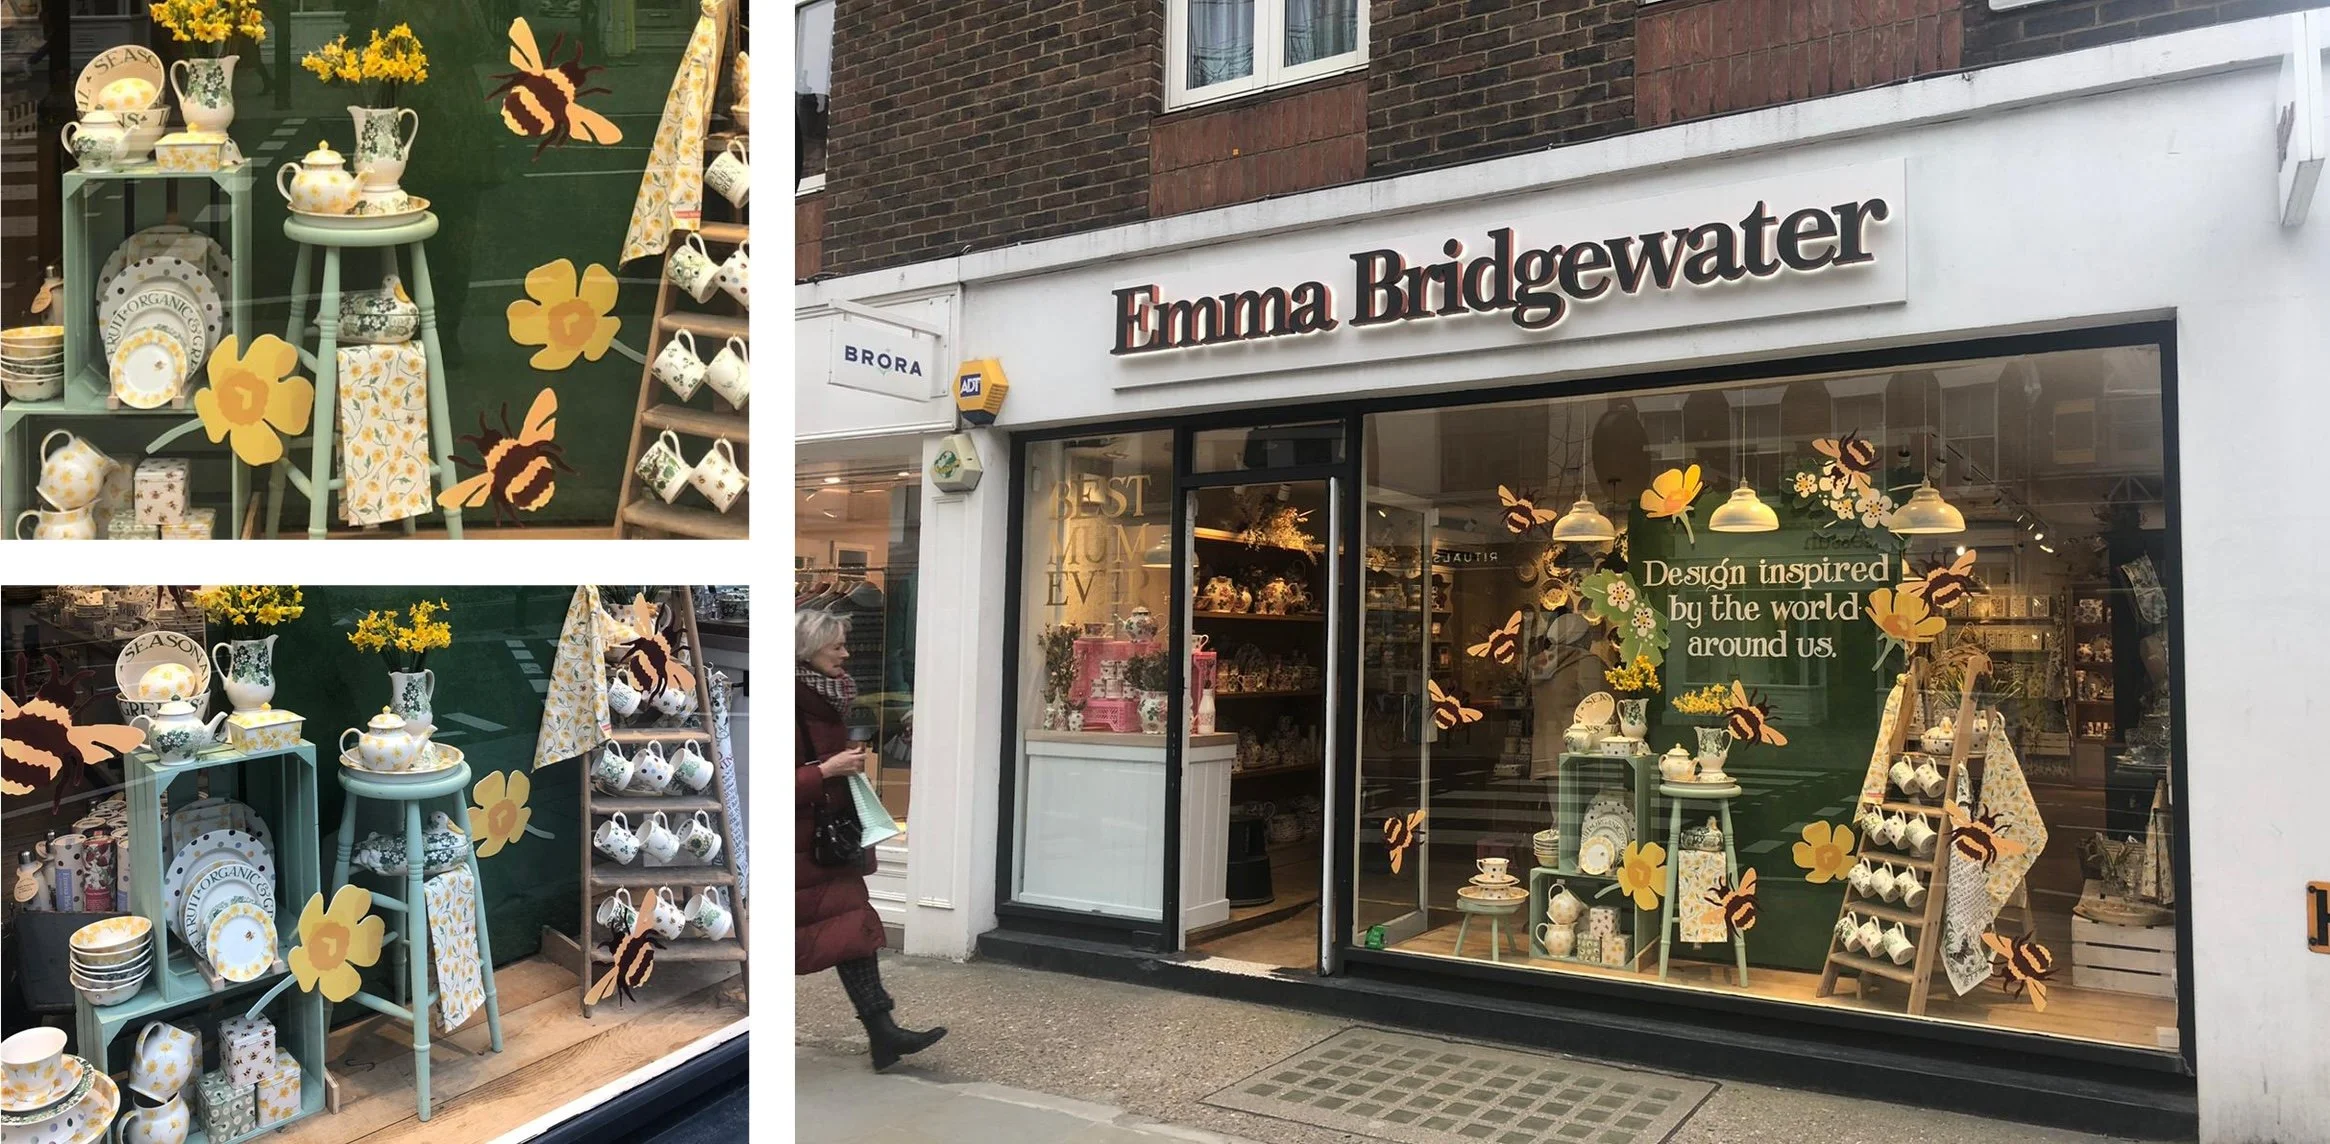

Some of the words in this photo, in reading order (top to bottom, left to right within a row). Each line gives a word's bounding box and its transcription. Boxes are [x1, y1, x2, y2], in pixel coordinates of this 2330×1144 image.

[1110, 282, 1339, 356] Emma
[1348, 199, 1888, 331] Bridgewater
[127, 293, 194, 318] ORGANIC
[845, 345, 922, 377] BRORA
[960, 377, 981, 394] ADT
[1049, 475, 1152, 520] BEST
[1047, 523, 1150, 565] MUM
[1643, 557, 1747, 592] Design
[1759, 553, 1890, 590] inspired
[1668, 594, 1703, 628] by
[1710, 594, 1761, 621] the
[1771, 592, 1859, 621] world
[1687, 630, 1787, 658] around
[1796, 636, 1837, 658] us.
[187, 894, 201, 938] FRUIT
[200, 866, 261, 890] ORGANIC
[256, 882, 270, 897] &
